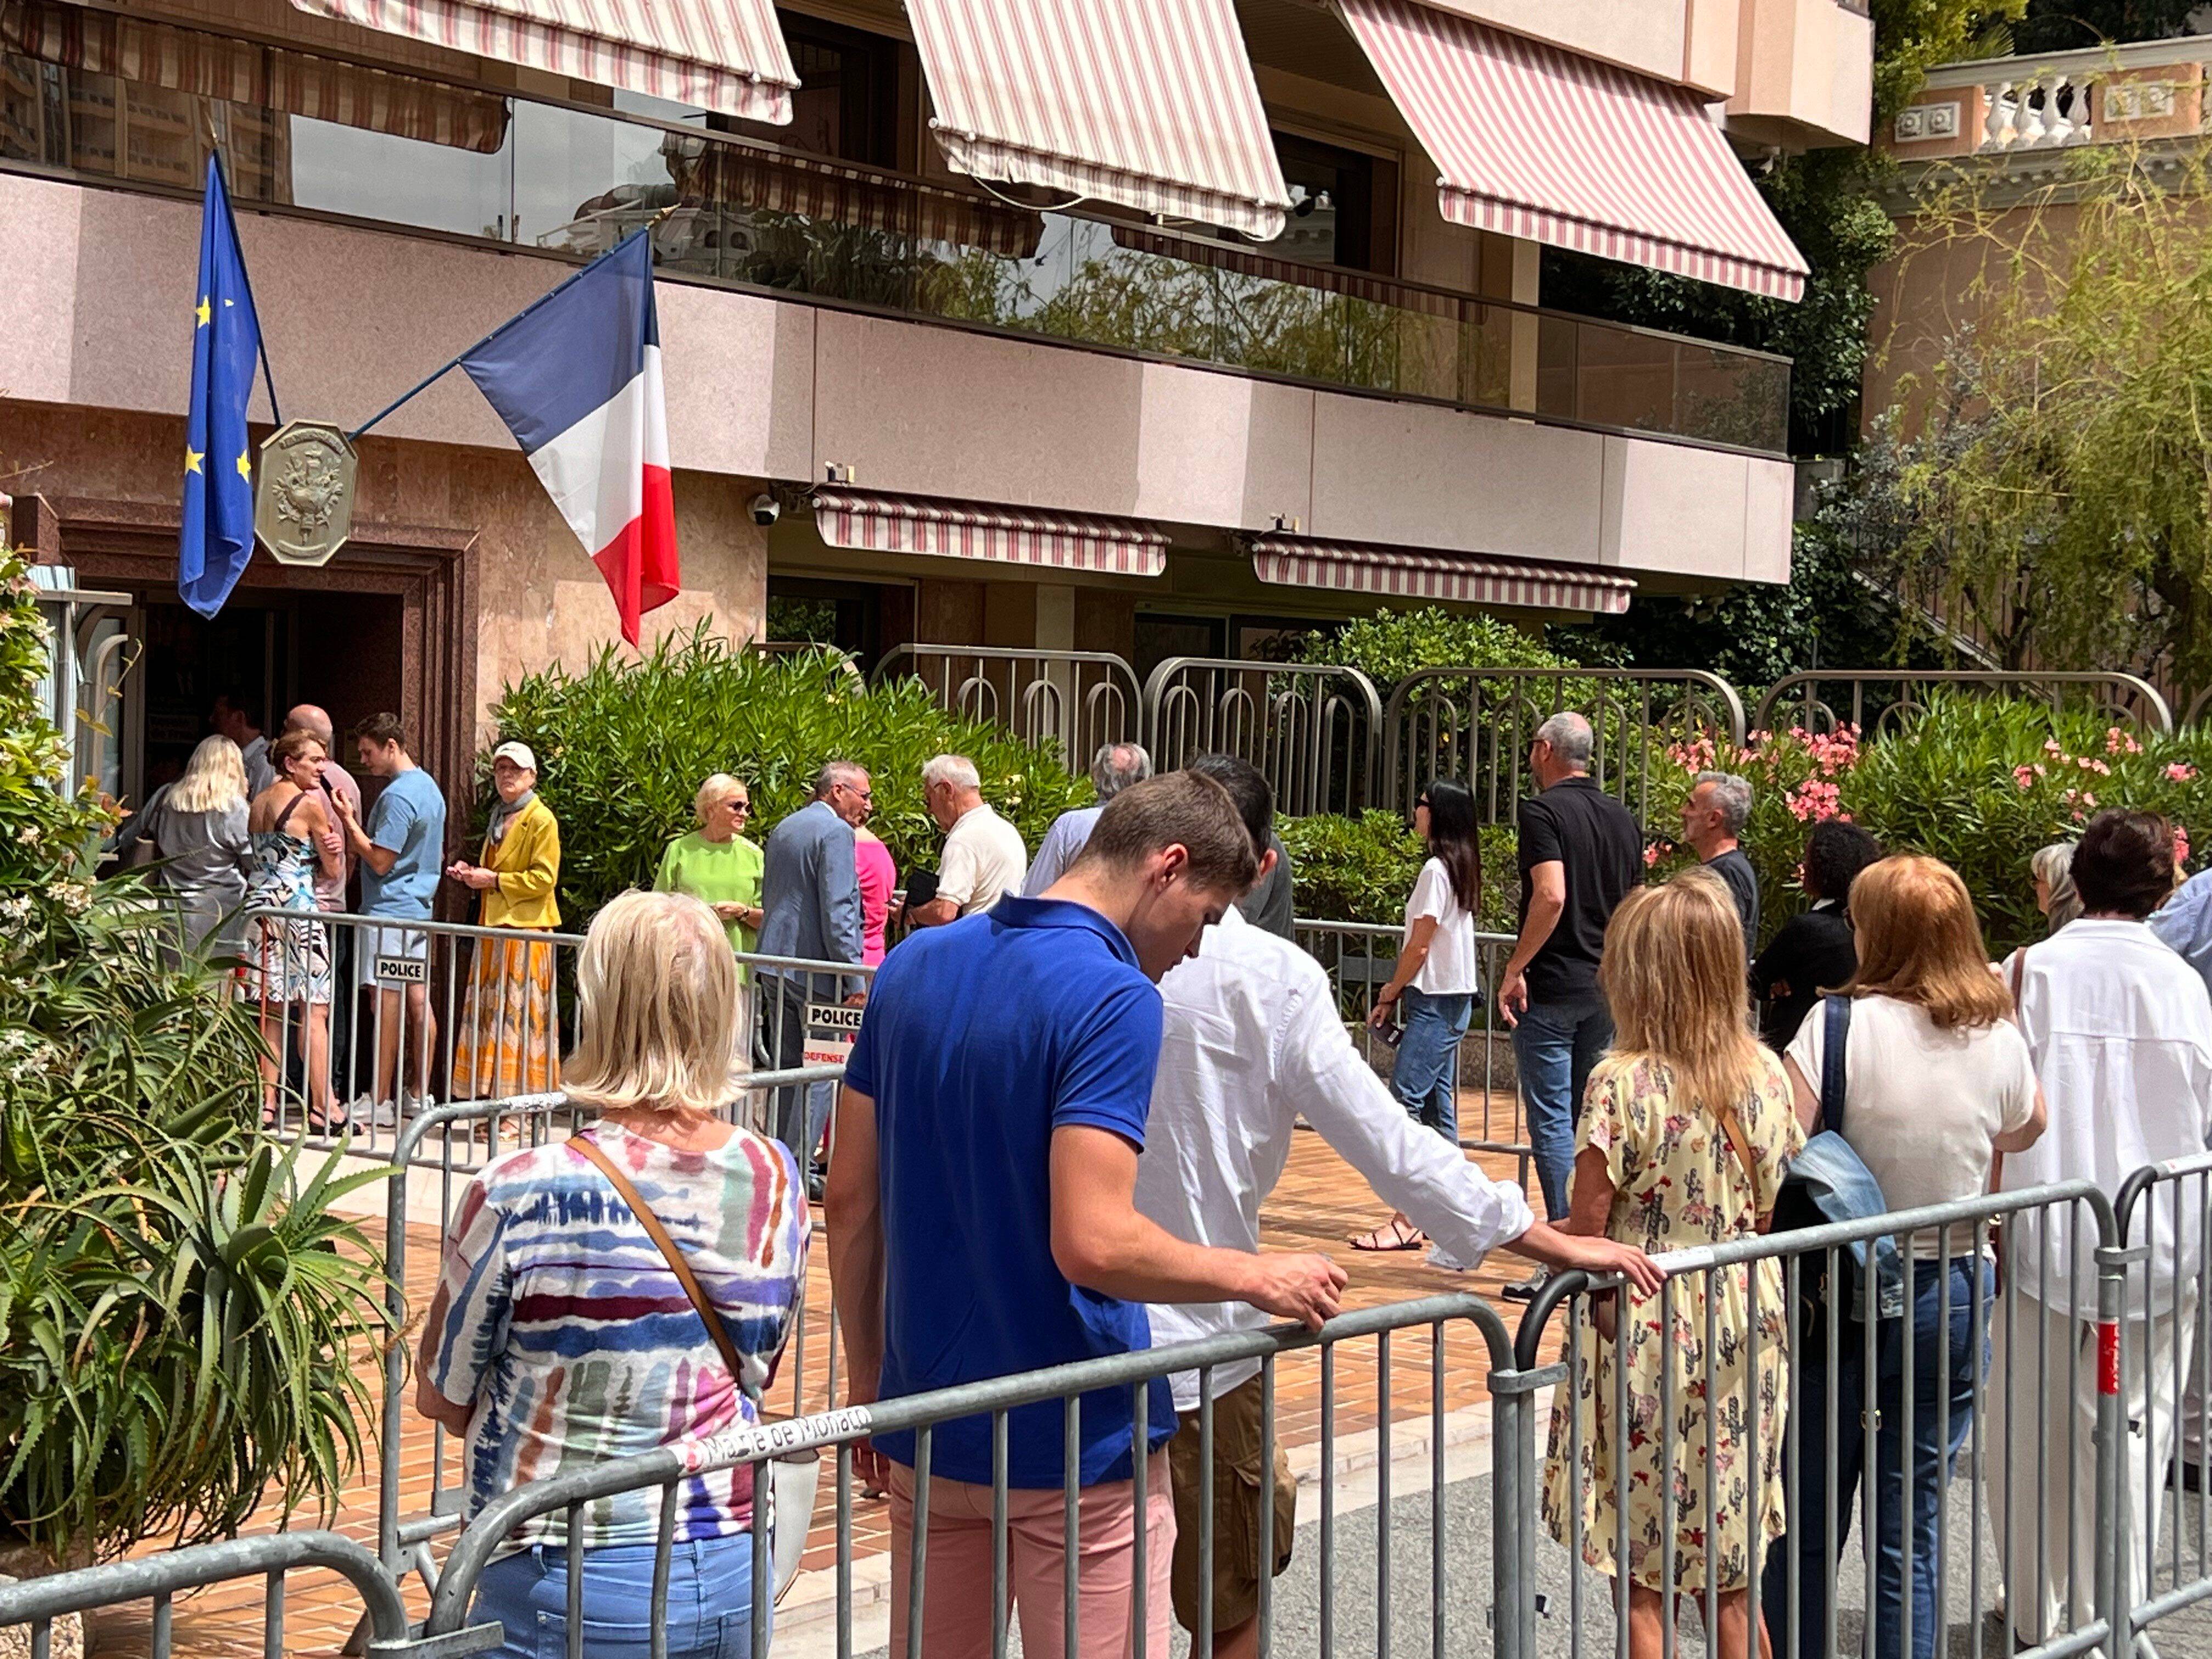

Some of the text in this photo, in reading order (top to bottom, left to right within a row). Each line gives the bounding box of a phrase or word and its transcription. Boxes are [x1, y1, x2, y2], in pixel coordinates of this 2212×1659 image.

[381, 962, 421, 978] POLICE
[812, 1008, 861, 1026] POLICE
[702, 1432, 766, 1463] Marie
